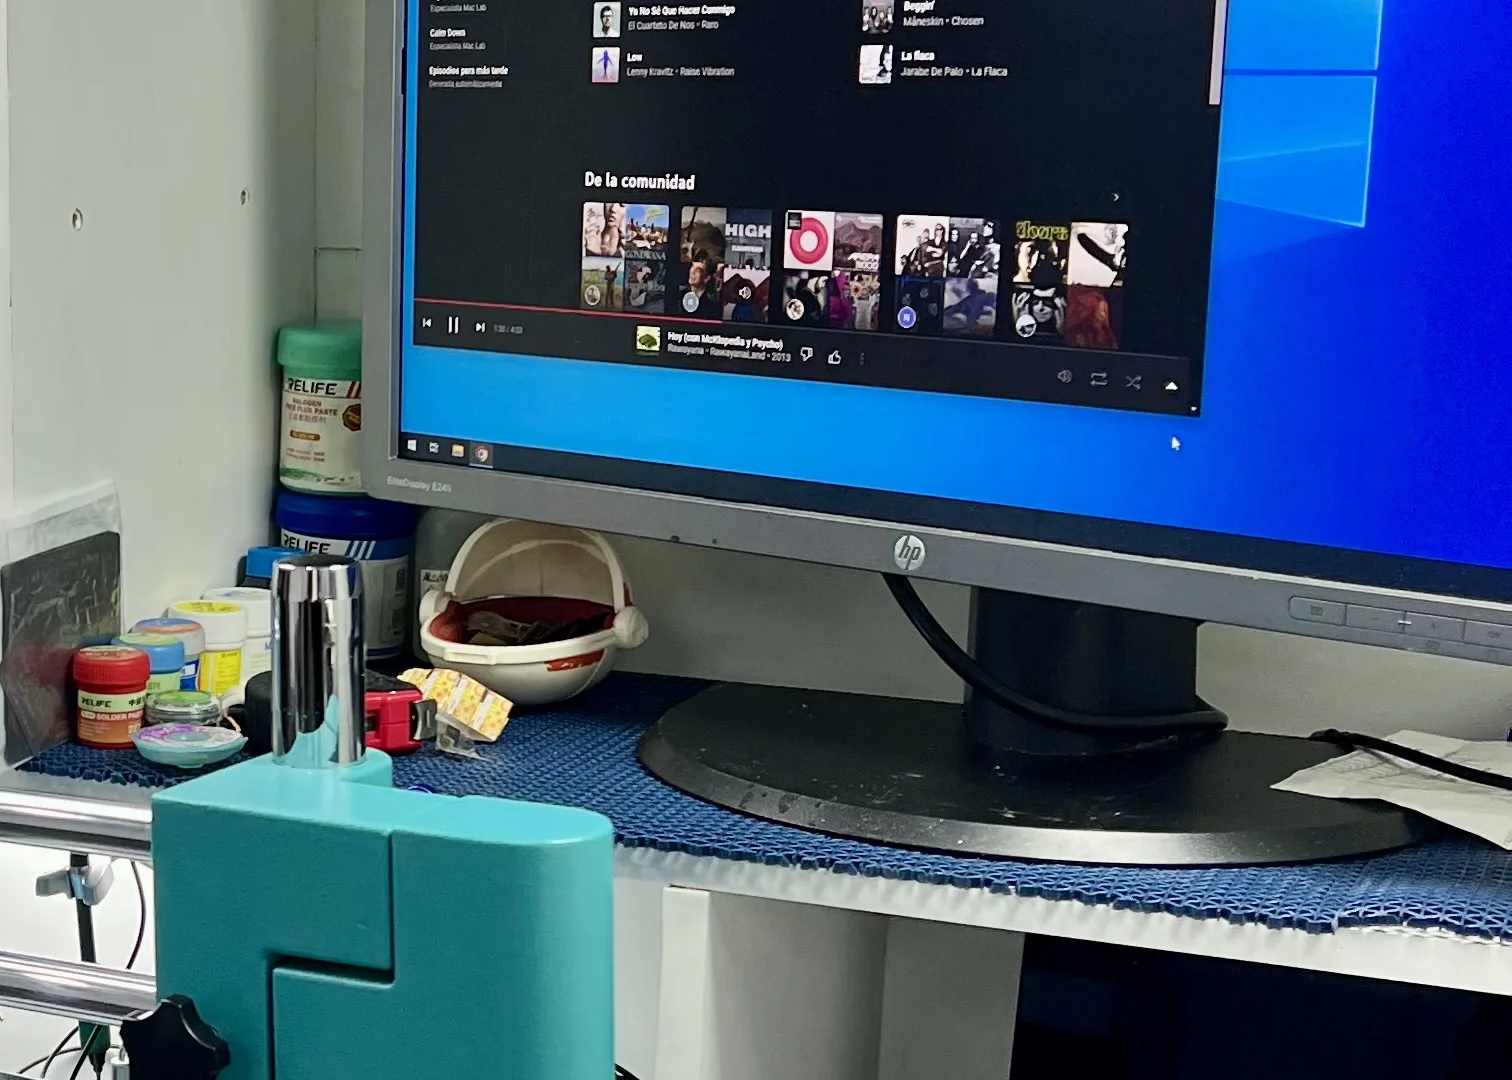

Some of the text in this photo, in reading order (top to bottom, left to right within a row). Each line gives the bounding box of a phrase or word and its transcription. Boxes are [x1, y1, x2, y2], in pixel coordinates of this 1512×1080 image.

[639, 7, 650, 15] No
[678, 6, 700, 15] Hacer
[701, 5, 735, 16] Conmigo
[669, 21, 678, 30] De
[680, 21, 695, 30] Nos
[951, 16, 984, 26] Chosen
[627, 53, 642, 62] Low
[901, 51, 912, 61] La
[429, 66, 459, 75] Episodios
[460, 67, 475, 76] para
[491, 66, 509, 75] tarde
[626, 67, 735, 78] Lenny Kravitz Raise Vibration
[900, 67, 929, 77] Jarabe
[931, 67, 943, 77] De
[971, 67, 982, 77] La
[984, 67, 1008, 77] Flaca
[585, 171, 695, 190] De la comunidad
[724, 223, 772, 238] HIGH
[771, 352, 791, 362] 2013
[287, 378, 338, 396] RELIFE
[314, 408, 338, 416] PASTE
[387, 475, 430, 491] EliteDisplay
[898, 534, 922, 570] hp
